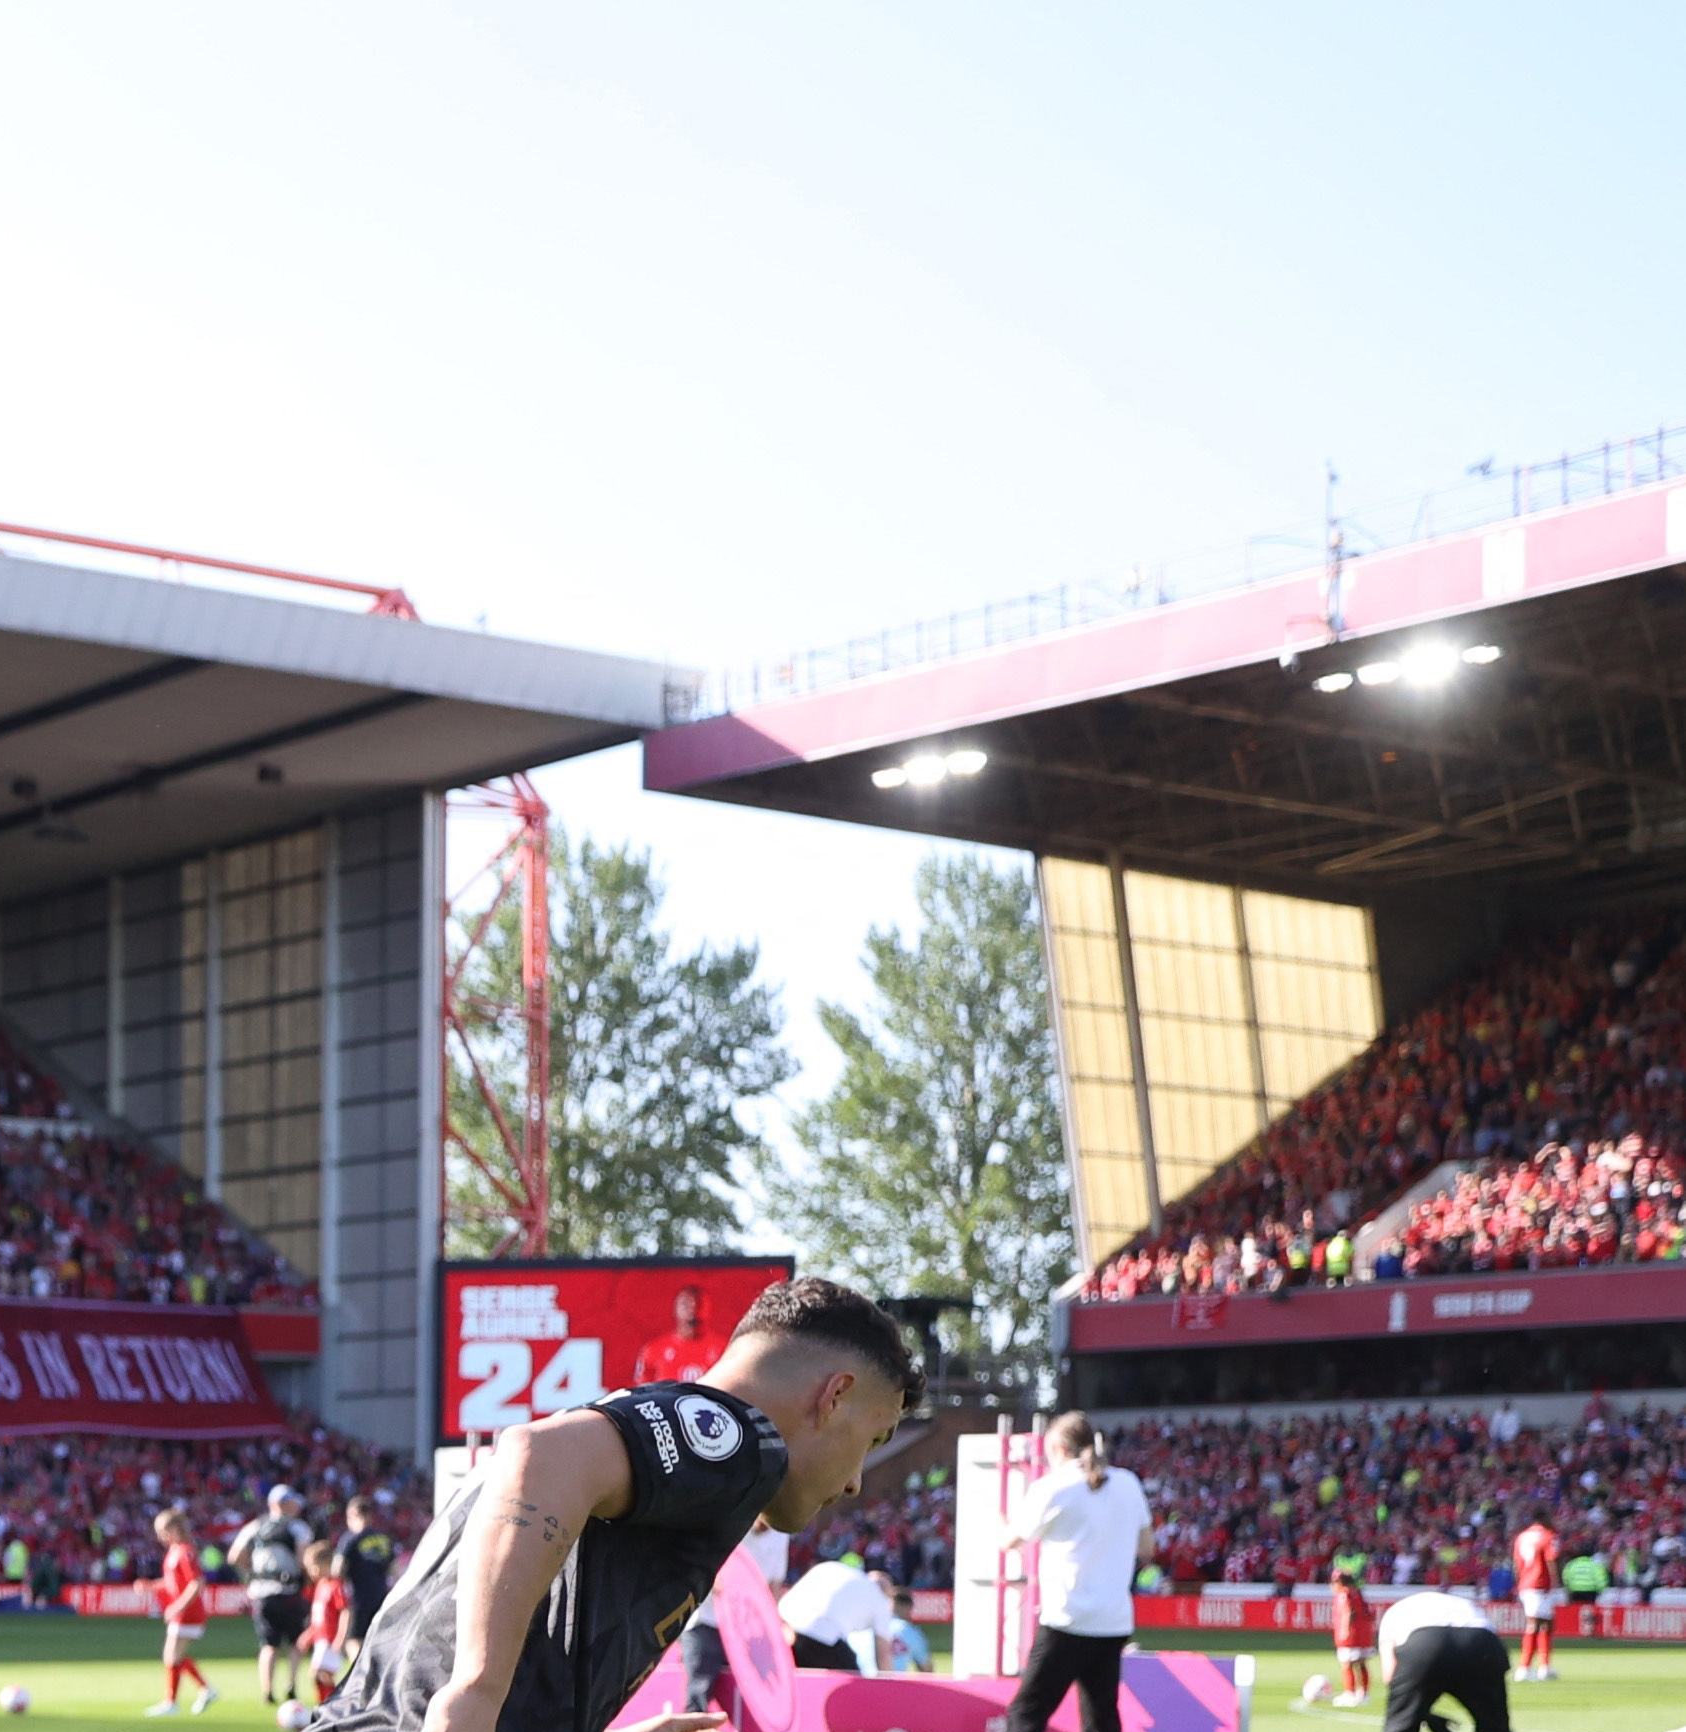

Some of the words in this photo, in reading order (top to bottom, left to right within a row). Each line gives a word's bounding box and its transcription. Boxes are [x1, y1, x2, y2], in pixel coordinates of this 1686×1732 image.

[20, 1330, 81, 1400] IN
[76, 1332, 258, 1406] RETURN!
[459, 1337, 609, 1432] 24
[650, 1422, 674, 1474] racism
[660, 1420, 679, 1464] room
